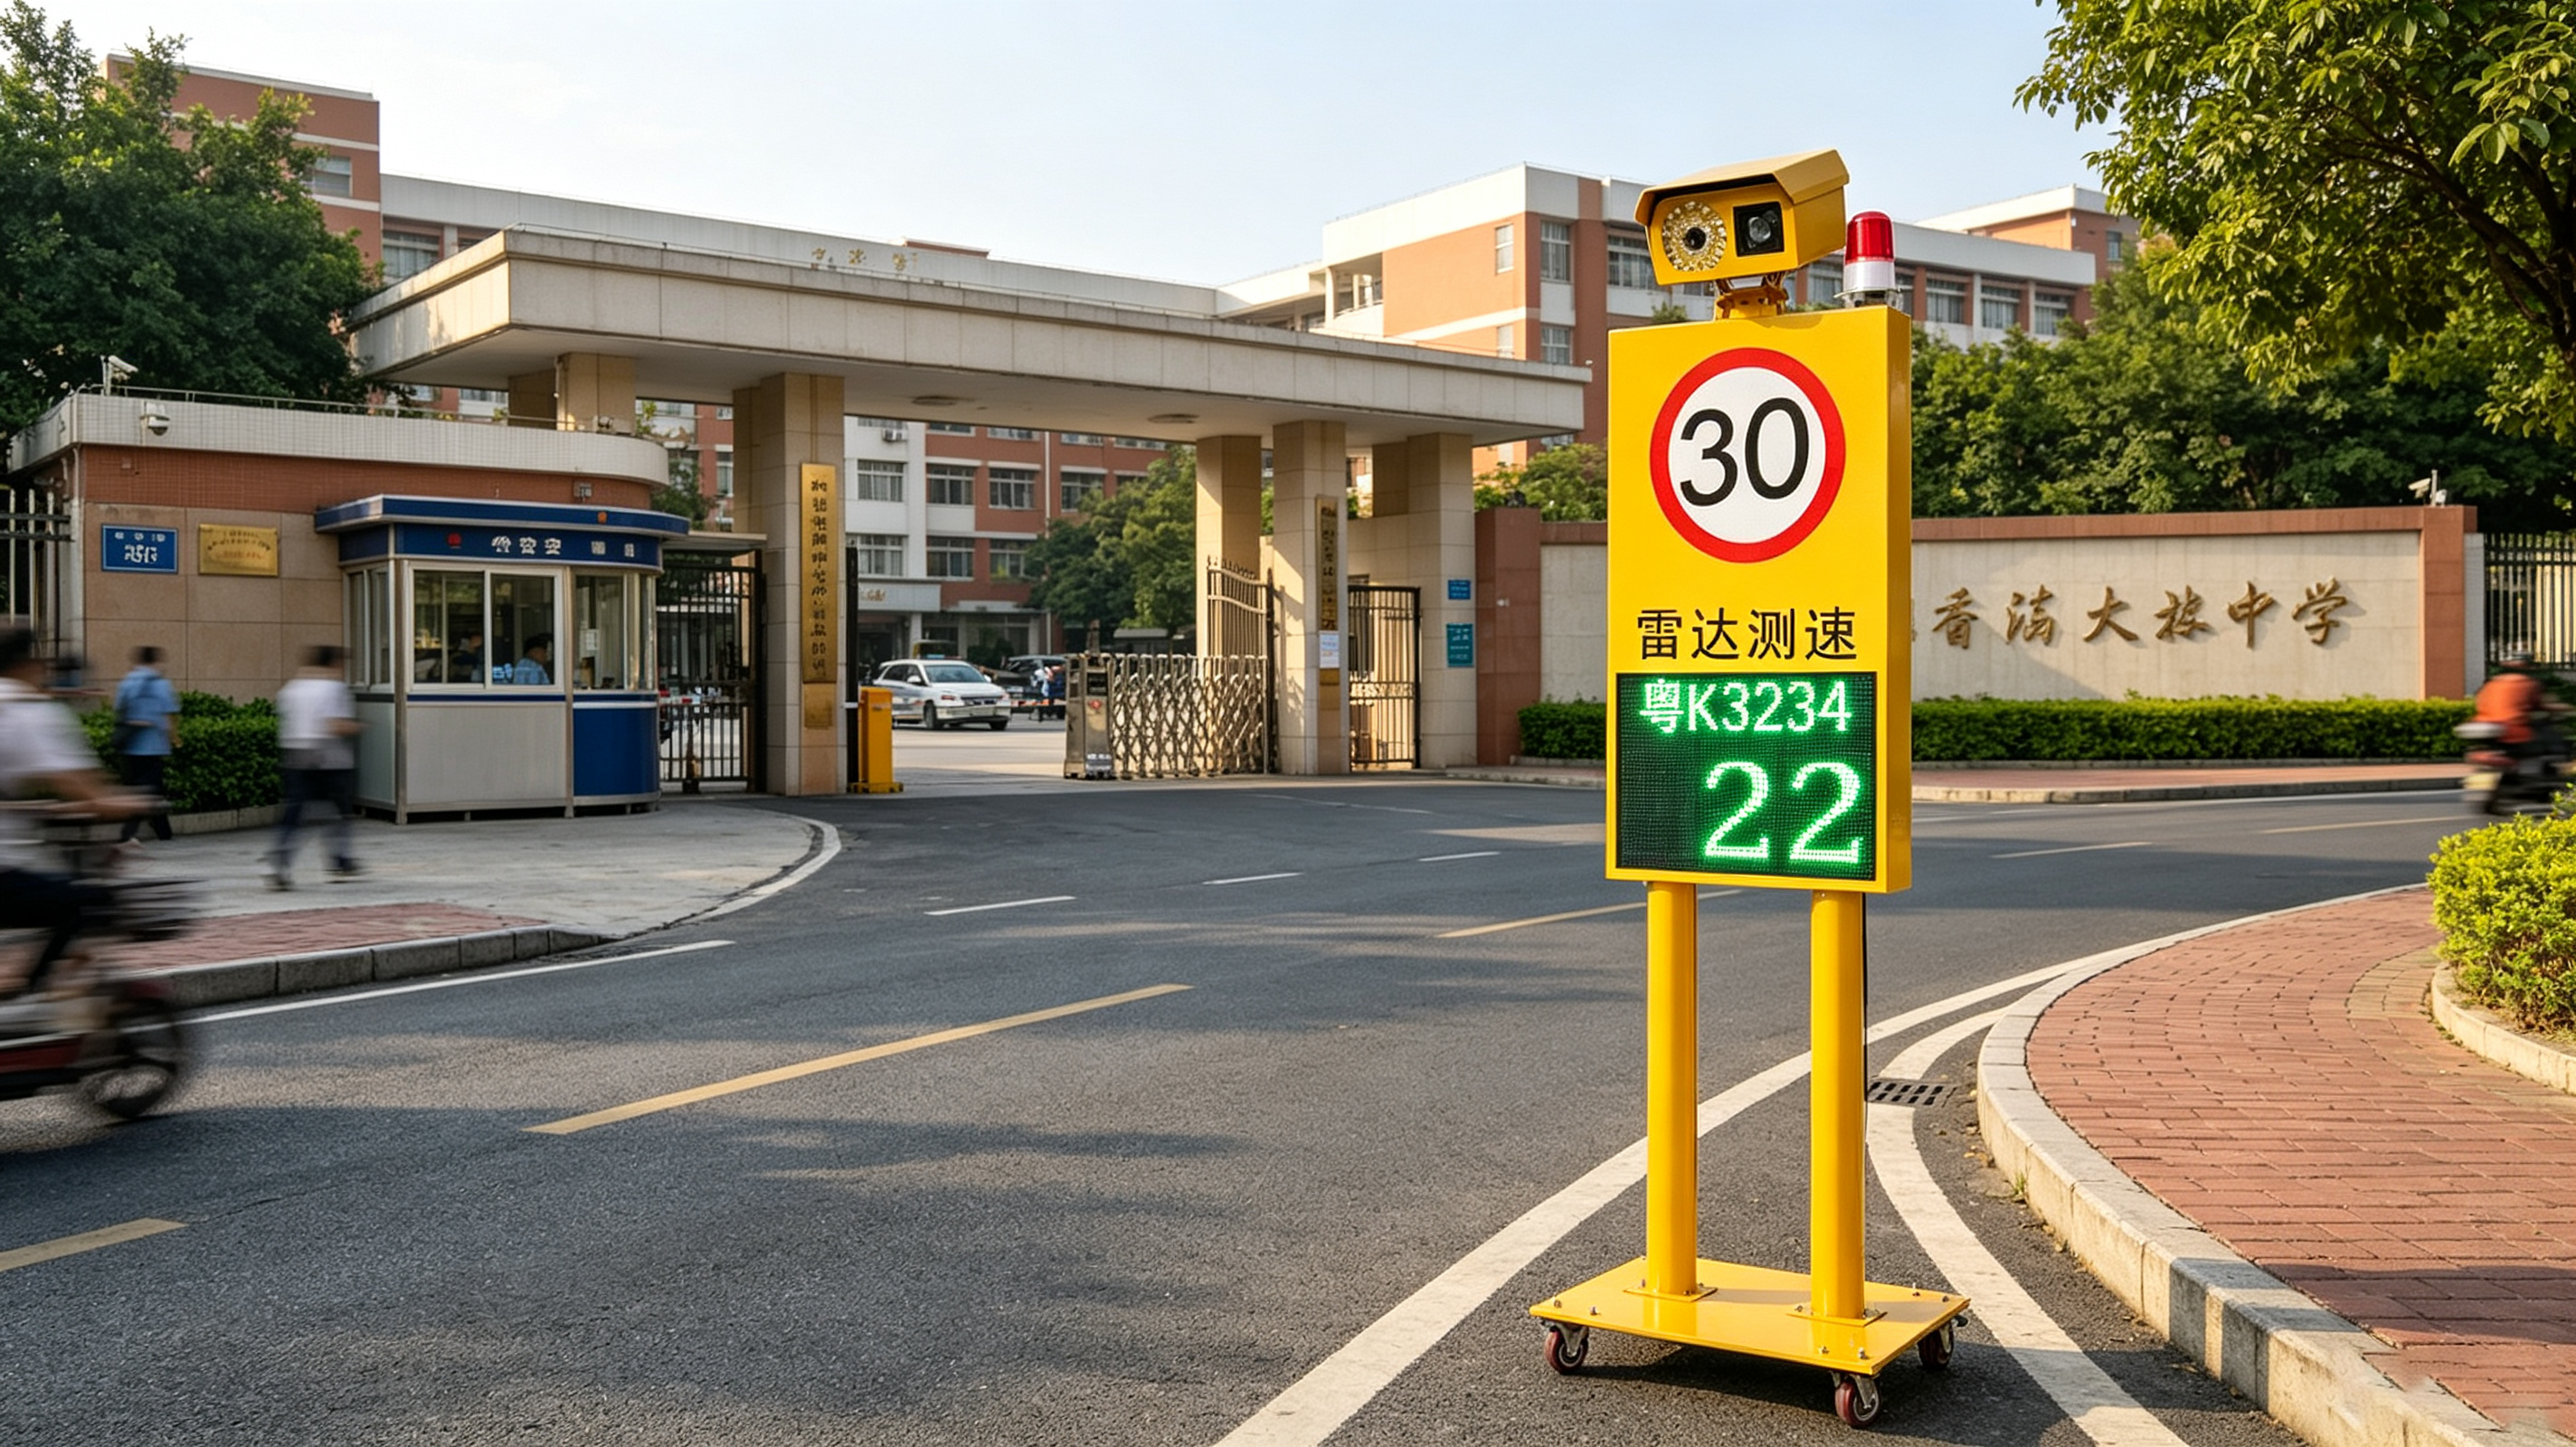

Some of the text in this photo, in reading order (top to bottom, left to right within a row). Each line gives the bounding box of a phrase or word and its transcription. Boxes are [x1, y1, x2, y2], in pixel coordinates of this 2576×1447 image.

[1680, 397, 1810, 507] 30
[1637, 606, 1858, 661] 雷达测速
[1639, 678, 1852, 733] 粤K3234
[1704, 761, 1861, 864] 22
